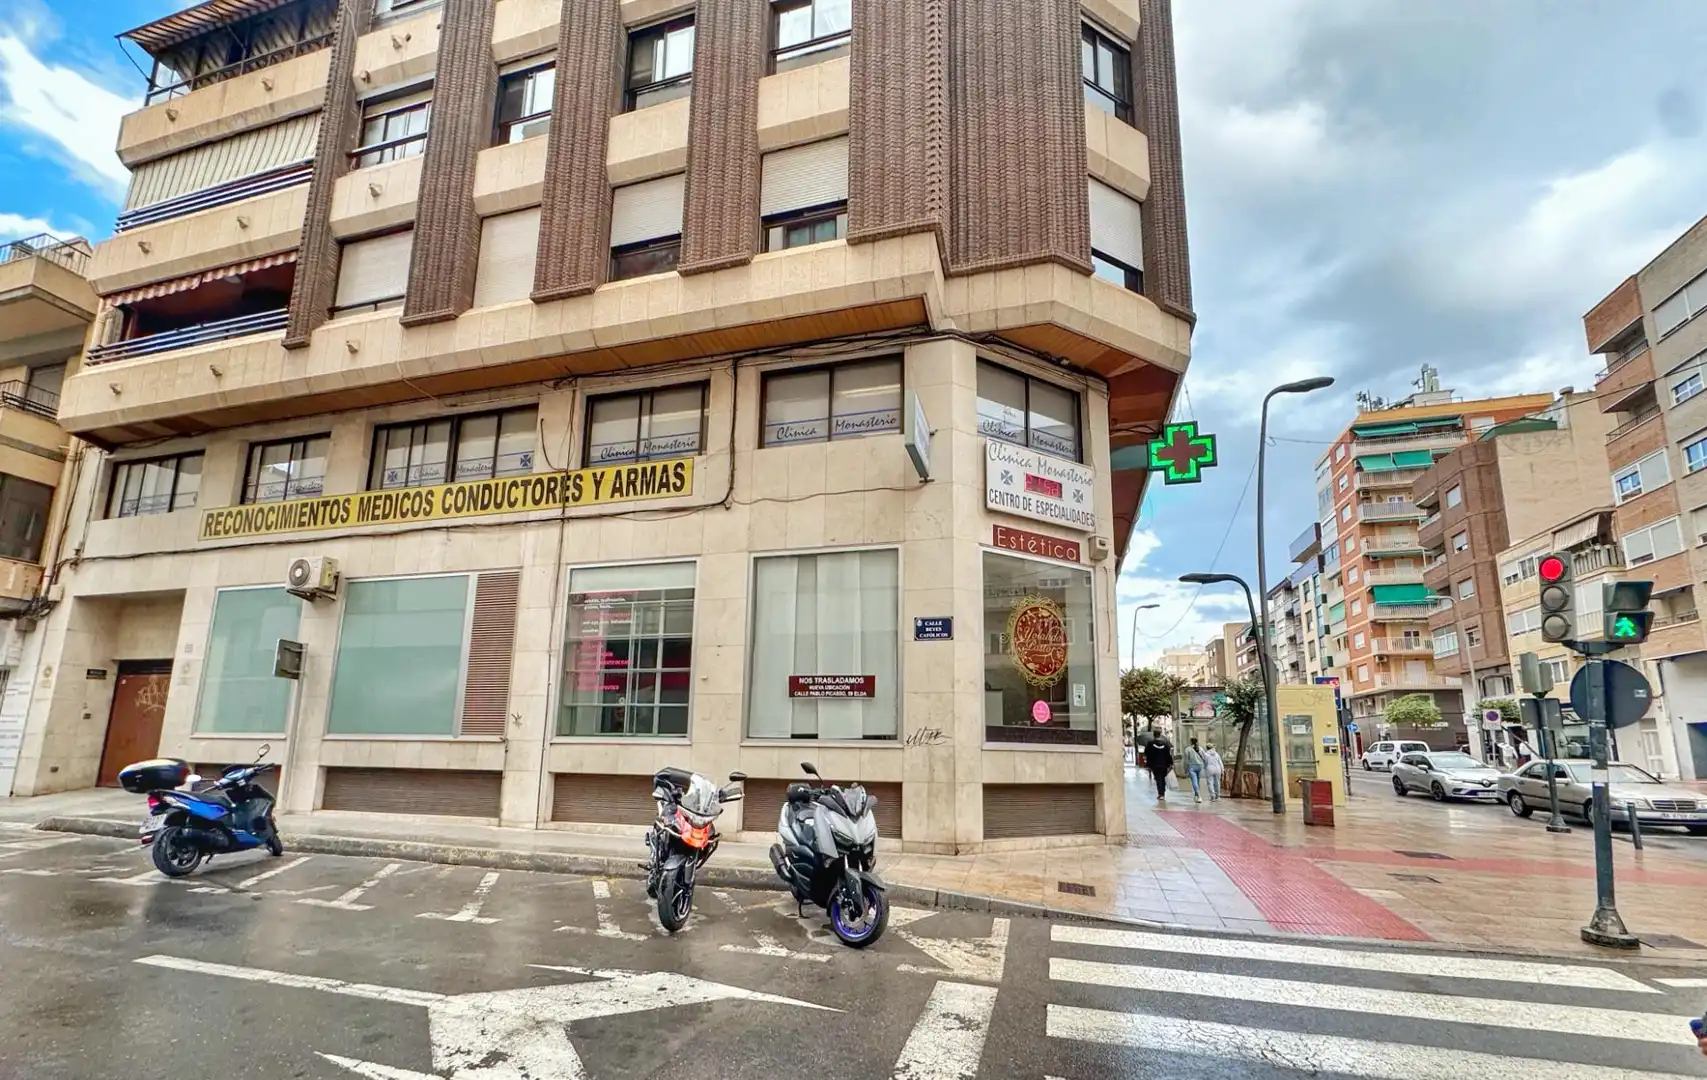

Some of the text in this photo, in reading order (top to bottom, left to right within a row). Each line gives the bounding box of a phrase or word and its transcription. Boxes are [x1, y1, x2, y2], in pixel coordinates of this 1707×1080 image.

[834, 414, 897, 432] Monasterio
[643, 438, 697, 453] Monasterio
[1031, 432, 1076, 454] Monasterio
[456, 461, 494, 474] Monasteri
[1037, 456, 1093, 487] Monasterio
[203, 496, 351, 537] RECONOCIMIENTOS
[356, 489, 435, 523] MEDICOS
[441, 473, 584, 516] CONDUCTORES
[591, 470, 606, 501] Y
[609, 461, 686, 504] ARMAS
[988, 488, 1096, 528] CENTRO DE ESPECIALIDADES
[996, 527, 1077, 560] Estética
